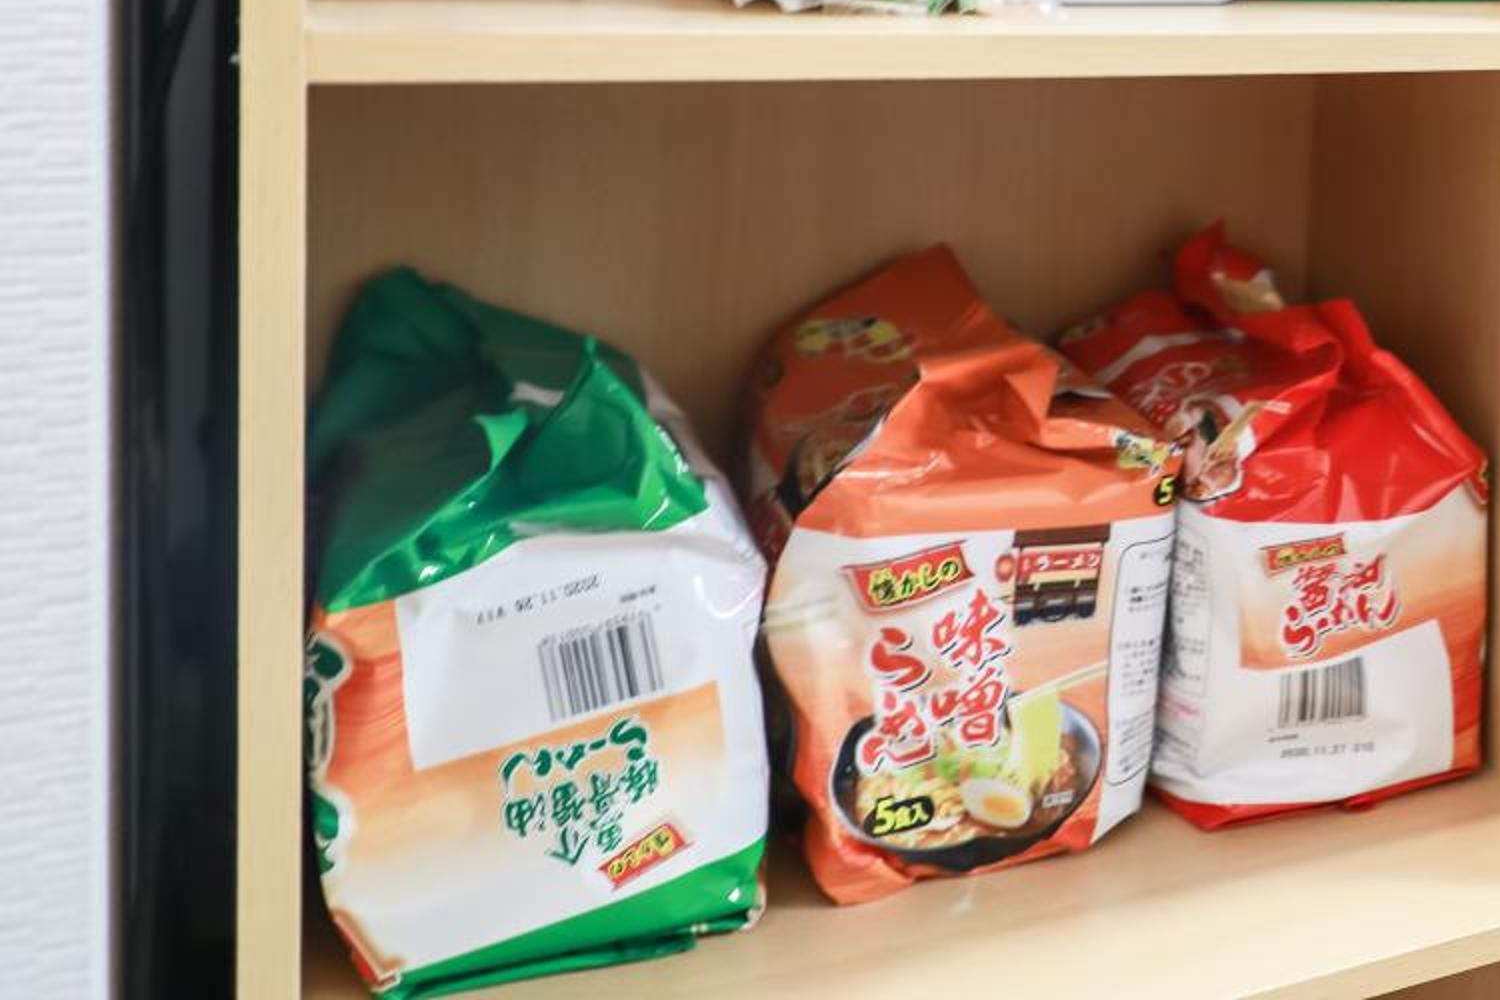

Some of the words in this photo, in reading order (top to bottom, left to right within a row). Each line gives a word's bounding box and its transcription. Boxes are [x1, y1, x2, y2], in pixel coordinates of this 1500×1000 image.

[869, 557, 961, 607] 懐かしの
[1292, 552, 1387, 613] 醤油
[1283, 587, 1398, 653] らーめん
[931, 587, 1007, 744] 味噌
